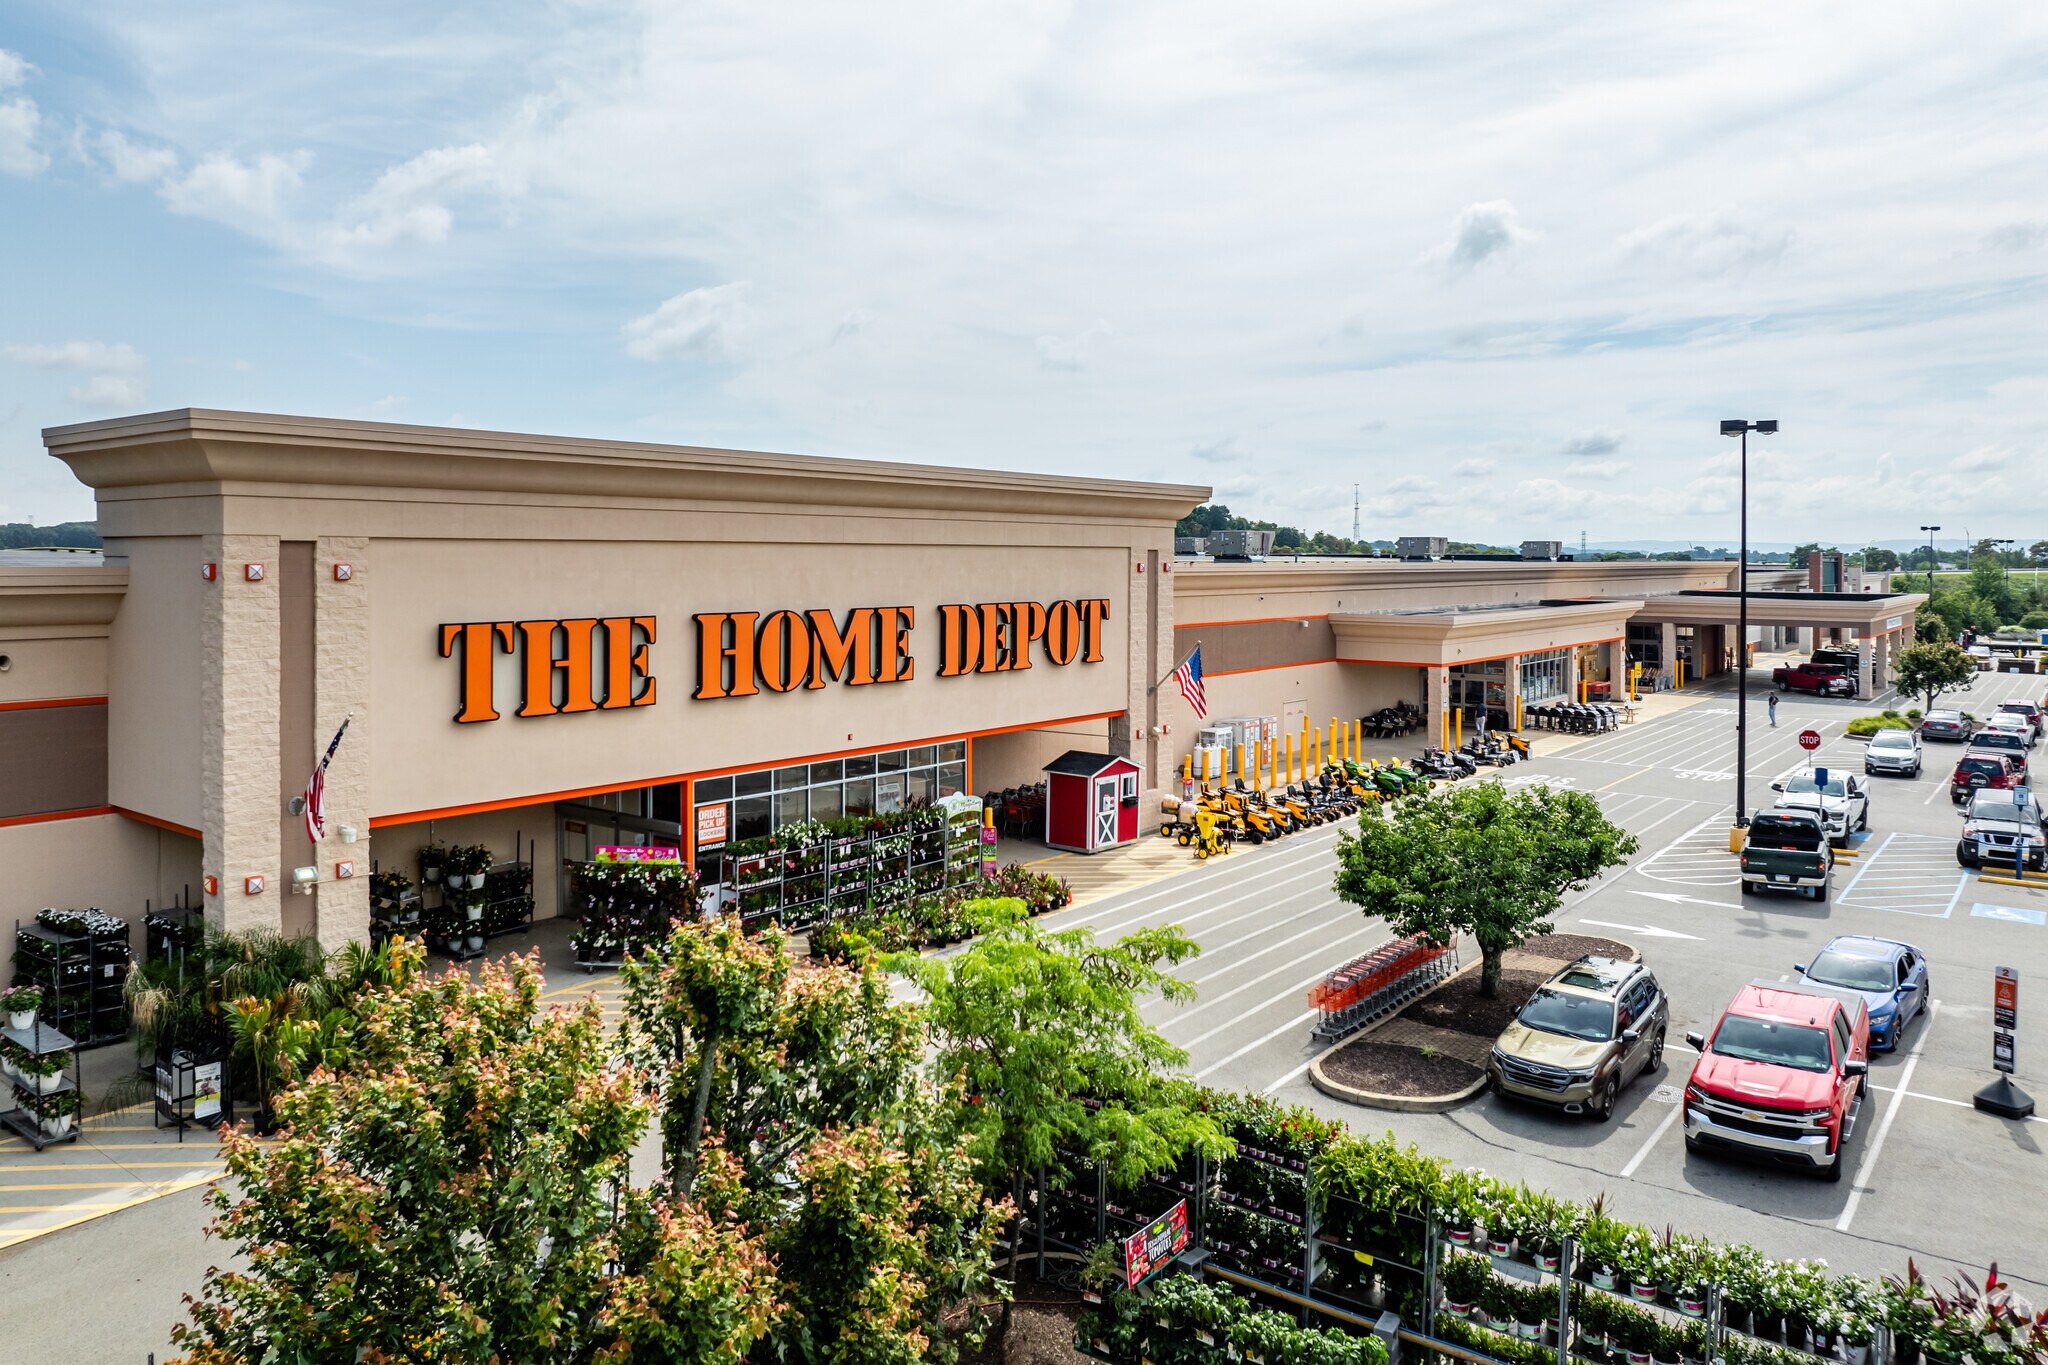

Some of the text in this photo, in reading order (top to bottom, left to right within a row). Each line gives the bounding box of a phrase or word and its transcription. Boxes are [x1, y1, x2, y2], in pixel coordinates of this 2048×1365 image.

[439, 599, 1110, 724] THE HOME DEPOT
[1800, 736, 1819, 744] STOP
[1513, 774, 1577, 784] STOP
[1674, 772, 1736, 781] STOP
[699, 807, 725, 820] ORDER
[699, 817, 725, 830] PICK UP
[700, 828, 725, 838] LOCKERS
[698, 842, 726, 852] ENTRANCE
[2002, 969, 2009, 977] 2
